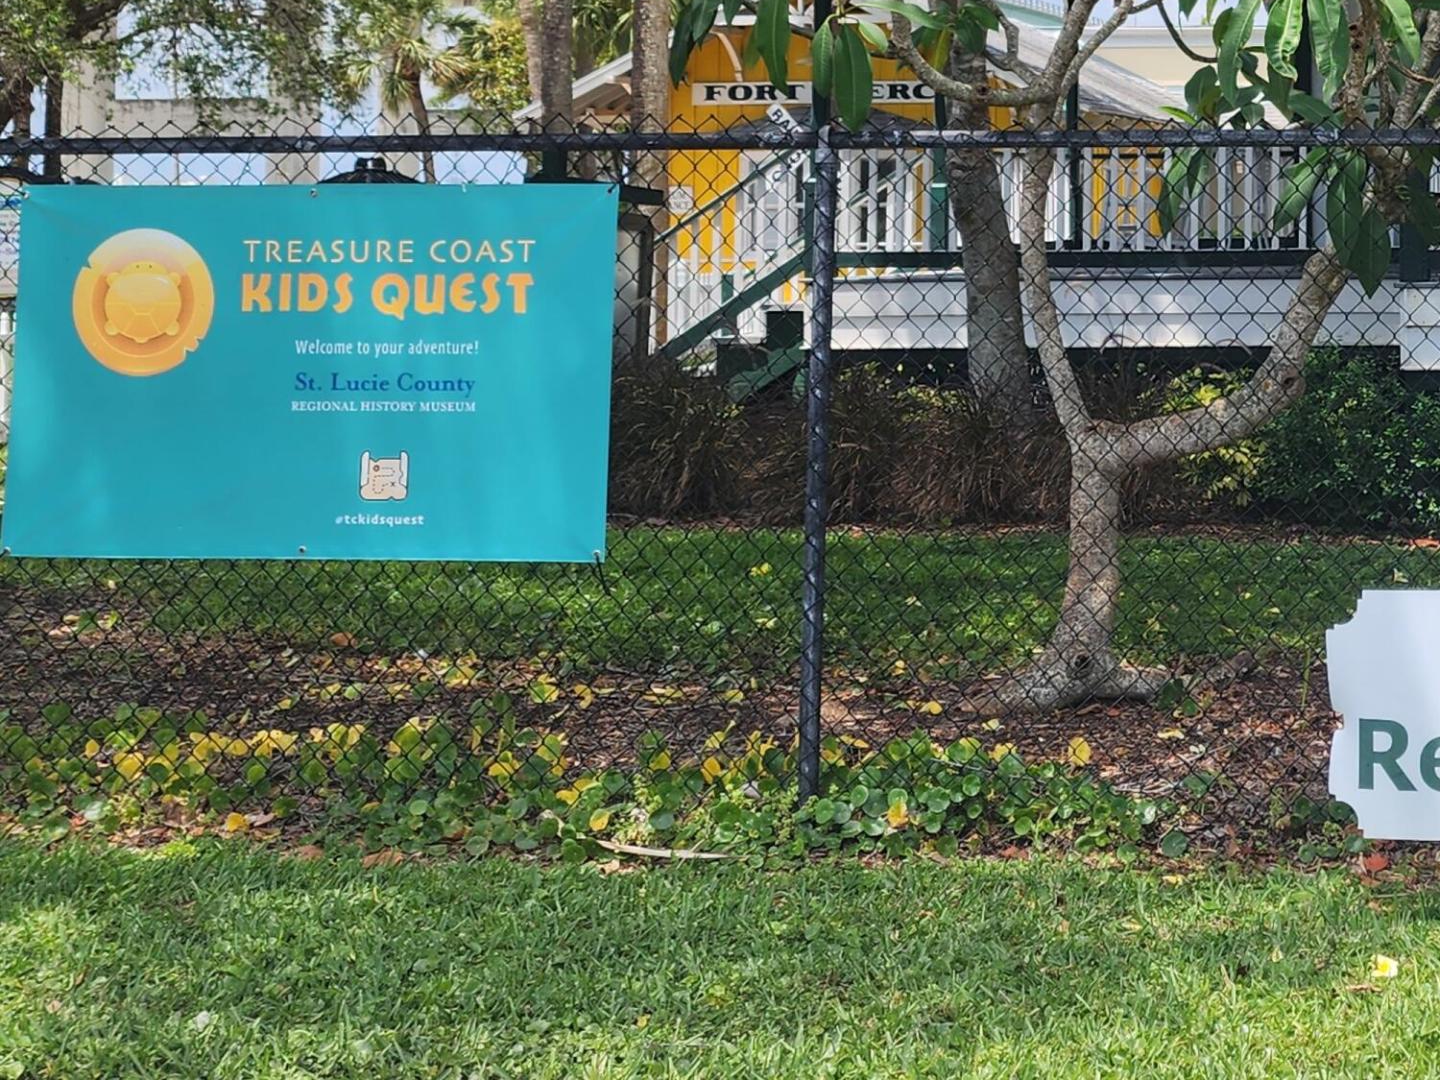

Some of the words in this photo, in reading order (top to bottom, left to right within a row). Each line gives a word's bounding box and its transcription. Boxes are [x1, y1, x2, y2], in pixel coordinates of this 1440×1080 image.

[704, 84, 804, 101] FORT
[243, 239, 414, 263] TREASURE
[429, 239, 536, 262] COAST
[241, 273, 354, 313] KIDS
[371, 273, 535, 320] QUEST
[295, 339, 353, 355] Welcome
[357, 341, 370, 355] to
[374, 342, 404, 358] your
[408, 339, 479, 355] adventure!
[294, 372, 322, 391] St.
[331, 372, 390, 391] Lucie
[397, 372, 476, 398] County
[291, 401, 358, 412] REGIONAL
[360, 401, 416, 412] HISTORY
[419, 401, 476, 412] MUSEUM
[335, 513, 425, 527] #tckidsquest
